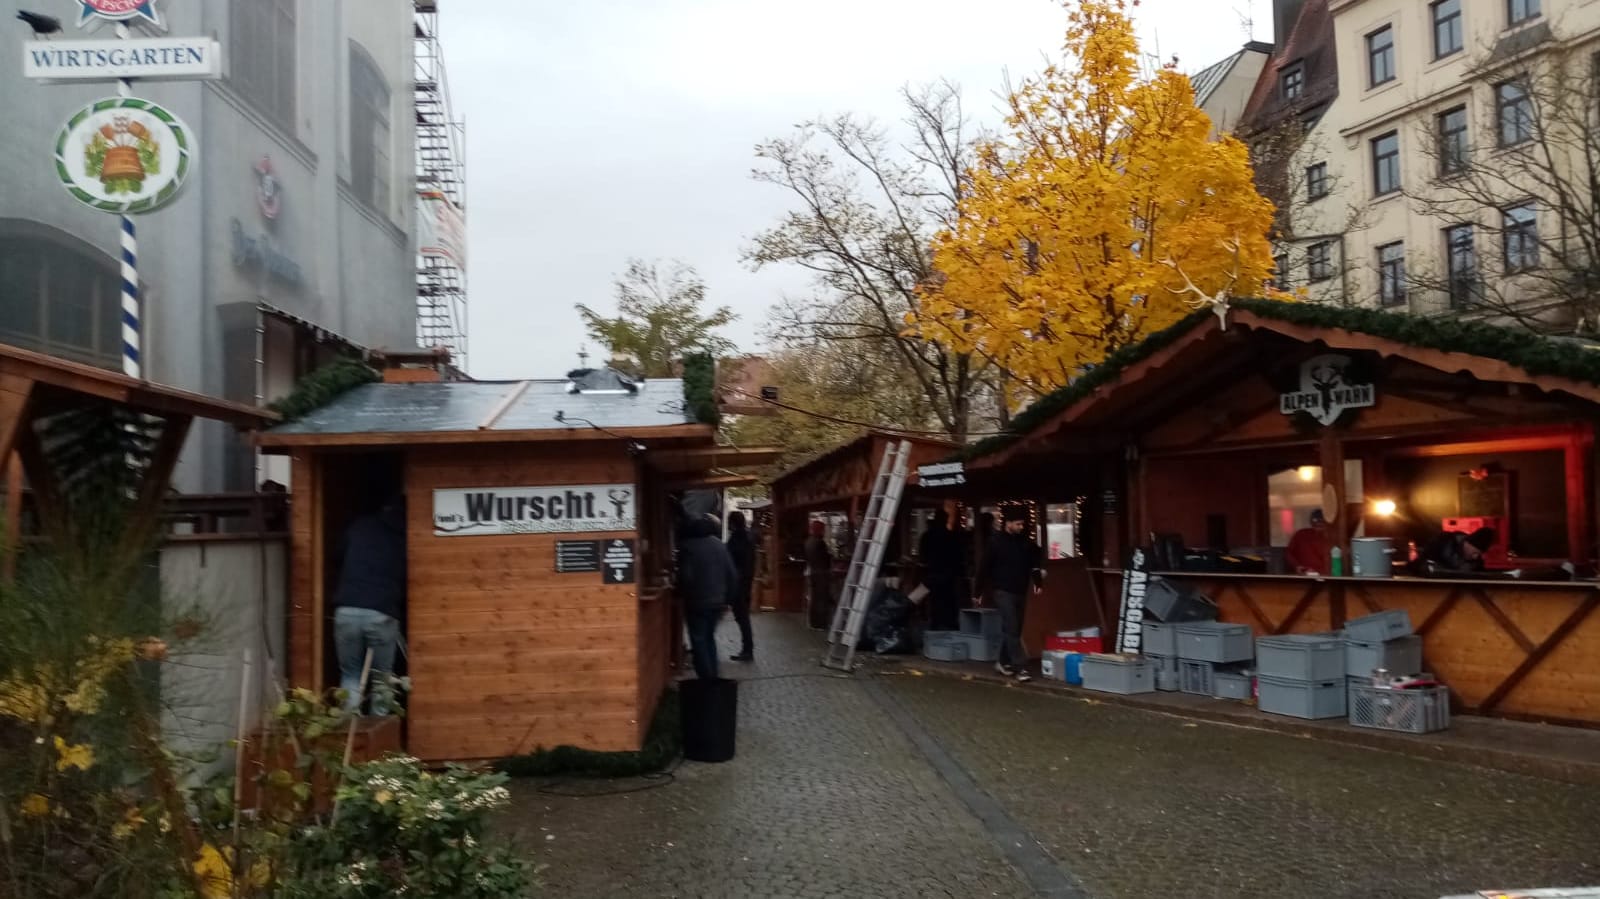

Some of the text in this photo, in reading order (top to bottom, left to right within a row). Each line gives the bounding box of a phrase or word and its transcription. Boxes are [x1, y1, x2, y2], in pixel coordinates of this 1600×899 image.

[32, 47, 204, 67] WIRTSGARTEN
[1284, 393, 1319, 410] ALPEN
[465, 490, 596, 522] Wurscht
